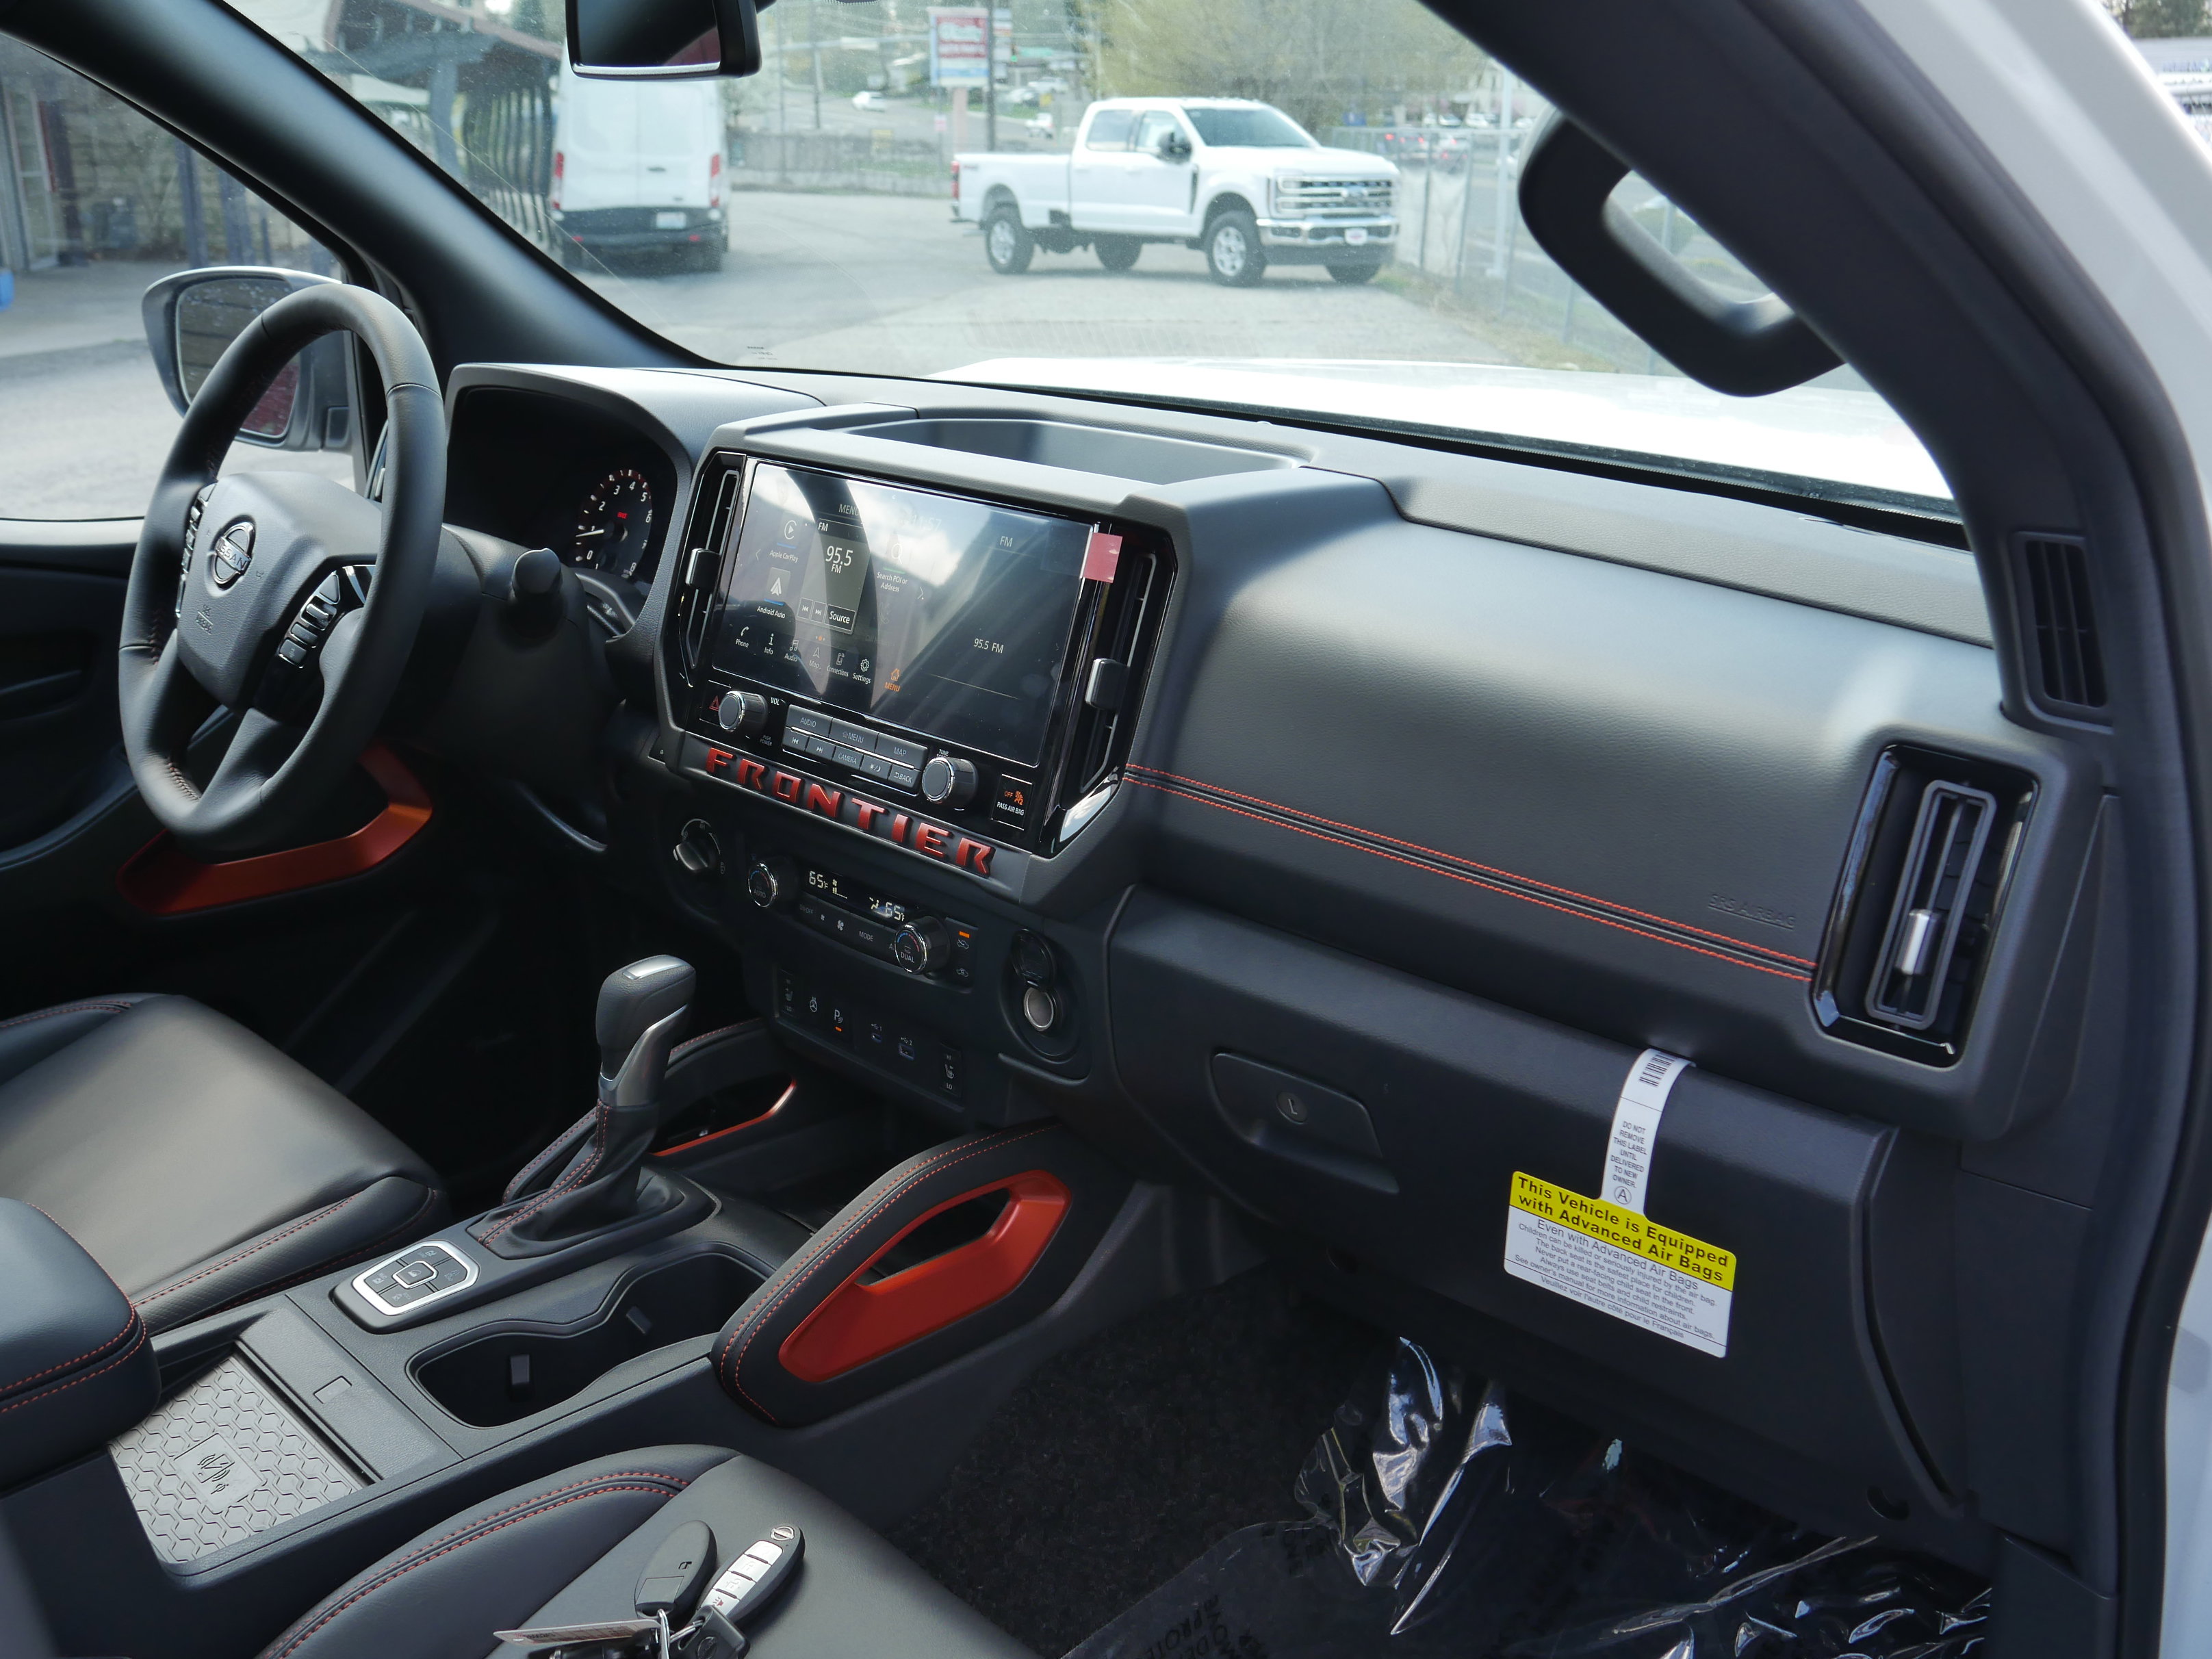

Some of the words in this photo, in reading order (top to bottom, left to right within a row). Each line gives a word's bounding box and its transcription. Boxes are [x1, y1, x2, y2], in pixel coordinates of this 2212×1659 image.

[613, 485, 620, 495] 3
[629, 481, 636, 491] 4
[640, 491, 647, 502] 5
[598, 501, 606, 511] 2
[645, 513, 652, 523] 6
[818, 522, 828, 532] FM
[1000, 535, 1012, 548] FM
[587, 550, 593, 561] 0
[769, 549, 782, 559] Apple
[782, 552, 799, 563] CarPlay
[825, 545, 853, 567] 95.5
[630, 562, 637, 572] 8
[831, 563, 842, 574] FM
[877, 571, 892, 581] Search
[892, 576, 902, 584] POI
[880, 582, 899, 592] Address
[757, 605, 775, 617] Android
[775, 610, 786, 619] Auto
[829, 610, 850, 624] Source
[735, 638, 749, 648] Phone
[973, 638, 990, 650] 95.5
[991, 642, 1004, 654] FM
[764, 647, 773, 655] Info
[784, 652, 798, 662] Audio
[809, 660, 819, 670] Map
[827, 665, 849, 678] Connections
[852, 672, 871, 685] Settings
[884, 682, 900, 692] MENU
[771, 697, 780, 706] VOL
[799, 717, 816, 728] AUDIO
[849, 731, 864, 743] MENU
[893, 746, 907, 756] MAP
[838, 752, 857, 764] CAMERA
[899, 773, 913, 784] BACK
[705, 747, 996, 876] FRONTIER
[996, 801, 1007, 810] PASS
[1015, 808, 1025, 816] BAG
[754, 888, 766, 899] AUTO
[859, 930, 873, 942] MODE
[901, 951, 915, 964] DUAL
[1623, 1121, 1632, 1129] DO
[1634, 1124, 1646, 1135] NOT
[1619, 1129, 1645, 1144] REMOVE
[1613, 1136, 1627, 1147] THIS
[1628, 1142, 1647, 1155] LABEL
[1620, 1149, 1637, 1161] UNTIL
[1610, 1155, 1644, 1172] DELIVERED
[1615, 1165, 1622, 1174] TO
[1624, 1168, 1638, 1179] NEW
[1617, 1189, 1628, 1203] A
[1519, 1176, 1552, 1198] This
[1558, 1192, 1619, 1224] Vehicle
[1625, 1218, 1640, 1233] is
[1647, 1226, 1729, 1267] Equipped
[1519, 1195, 1554, 1216] with
[1559, 1209, 1642, 1250] Advanced
[1648, 1244, 1673, 1261] Air
[1679, 1255, 1723, 1281] Bags
[1538, 1219, 1565, 1237] Even
[1567, 1232, 1589, 1248] with
[1591, 1240, 1647, 1270] Advanced
[1649, 1264, 1666, 1277] Air
[1669, 1270, 1699, 1291] Bags
[1519, 1223, 1547, 1239] Children
[1549, 1236, 1562, 1246] can
[1564, 1238, 1572, 1249] be
[1574, 1242, 1593, 1257] killed
[1603, 1257, 1635, 1274] seriously
[1637, 1269, 1662, 1285] injured
[1664, 1281, 1673, 1291] by
[1675, 1284, 1686, 1294] the
[1688, 1290, 1699, 1299] air
[1701, 1294, 1716, 1307] bag.
[1536, 1237, 1549, 1248] The
[1552, 1244, 1567, 1257] back
[1569, 1252, 1584, 1263] seat
[1586, 1257, 1593, 1265] is
[1594, 1261, 1606, 1271] the
[1608, 1266, 1629, 1280] safest
[1630, 1275, 1650, 1289] place
[1652, 1283, 1663, 1294] for
[1664, 1289, 1696, 1307] children.
[1535, 1246, 1556, 1259] Never
[1558, 1256, 1569, 1265] put
[1577, 1263, 1615, 1285] rear-facing
[1617, 1278, 1634, 1291] child
[1636, 1287, 1651, 1298] seat
[1653, 1291, 1660, 1300] in
[1662, 1296, 1674, 1307] the
[1675, 1302, 1695, 1315] front.
[1540, 1257, 1565, 1272] Always
[1567, 1268, 1580, 1277] use
[1581, 1273, 1597, 1284] seat
[1598, 1279, 1615, 1292] belts
[1617, 1287, 1630, 1298] and
[1632, 1292, 1649, 1306] child
[1651, 1302, 1688, 1321] restraints.
[1515, 1254, 1529, 1265] See
[1530, 1261, 1557, 1277] owner's
[1558, 1272, 1584, 1287] manual
[1586, 1282, 1595, 1292] for
[1597, 1287, 1615, 1300] more
[1617, 1296, 1658, 1317] information
[1660, 1313, 1681, 1326] about
[1682, 1320, 1693, 1330] air
[1694, 1326, 1715, 1340] bags.
[1541, 1275, 1568, 1292] Veuillez
[1569, 1286, 1582, 1298] voir
[1584, 1293, 1606, 1307] l'autre
[1608, 1302, 1623, 1313] côté
[1625, 1311, 1643, 1322] pour
[1643, 1316, 1650, 1324] le
[1651, 1320, 1684, 1339] Français
